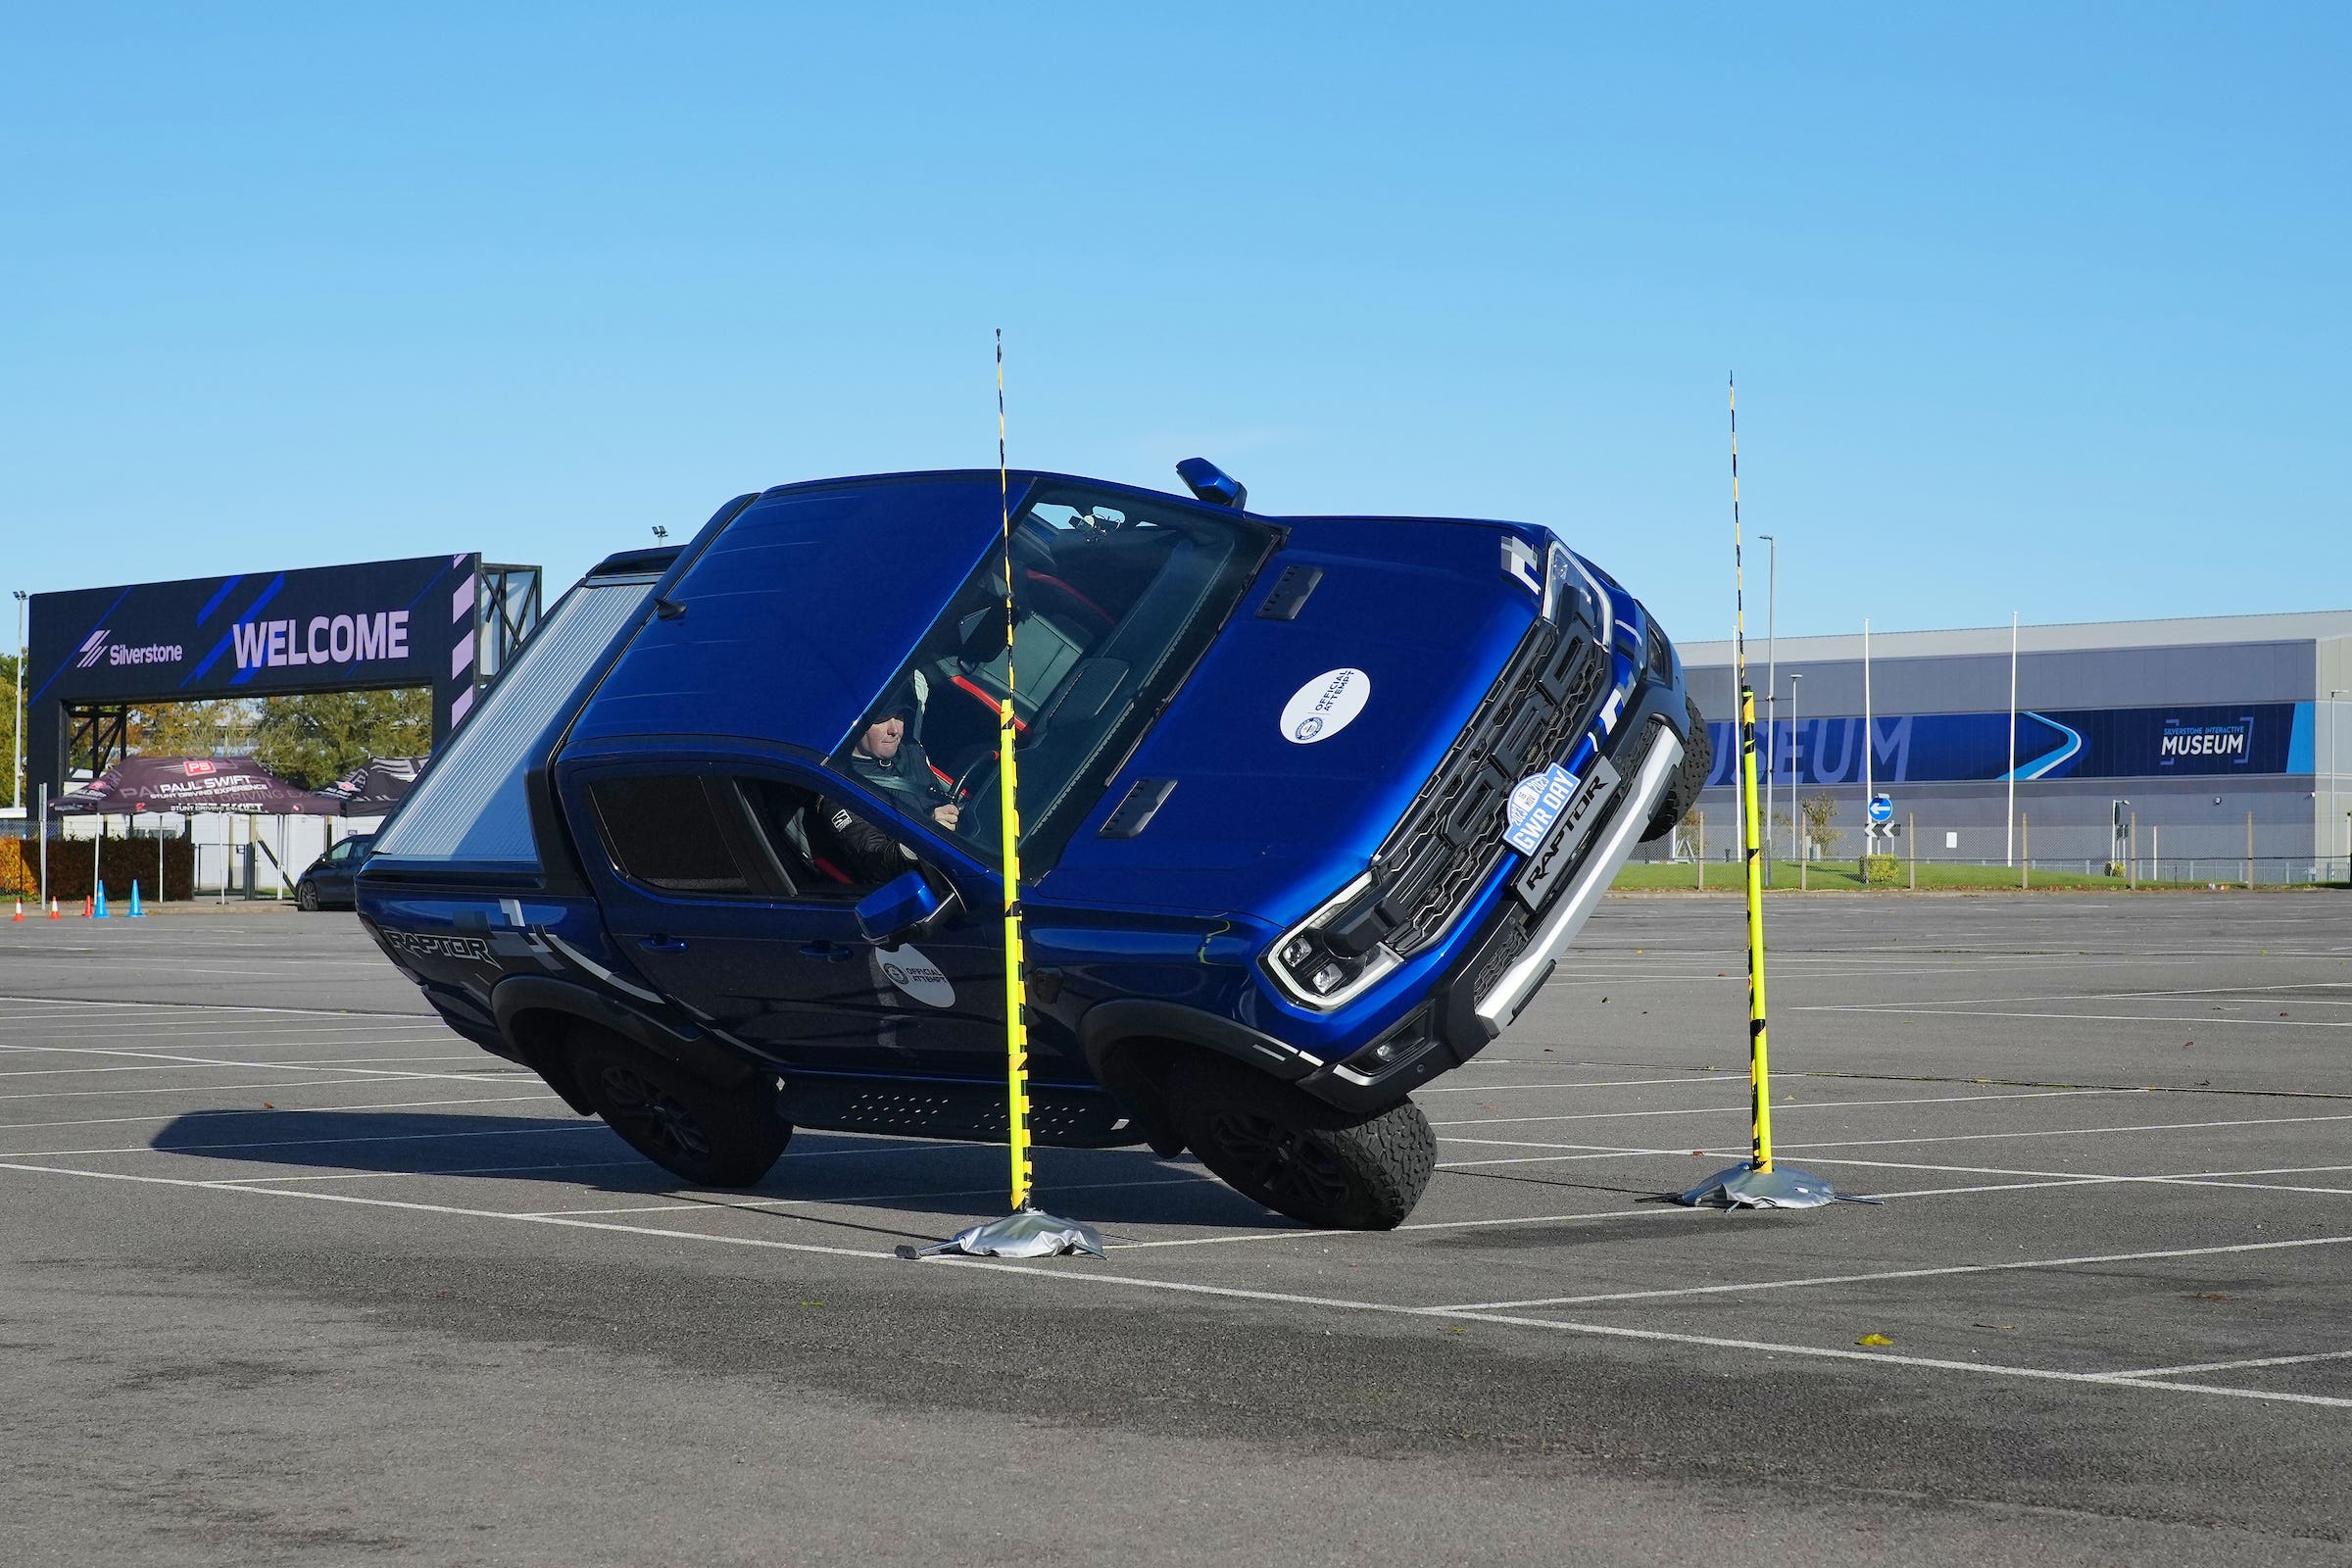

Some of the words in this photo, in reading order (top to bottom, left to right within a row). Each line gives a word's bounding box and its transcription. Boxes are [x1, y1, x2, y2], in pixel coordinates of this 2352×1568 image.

[109, 643, 183, 666] Silverstone
[232, 610, 410, 669] WELCOME
[1315, 669, 1348, 711] OFFICIAL
[1323, 670, 1354, 711] ATTEMPT
[2161, 734, 2244, 756] MUSEUM
[2204, 725, 2245, 734] INTERACTIVE
[160, 783, 202, 794] PAUL
[204, 774, 252, 789] SWIFT
[177, 788, 214, 799] DRIVING
[1511, 803, 1529, 826] 2023
[1527, 775, 1550, 795] 2023
[1512, 808, 1552, 851] GWR
[1543, 769, 1575, 811] DAY
[1526, 775, 1609, 892] RAPTOR
[383, 929, 504, 971] RAPTOR
[906, 967, 943, 976] OFFICIAL
